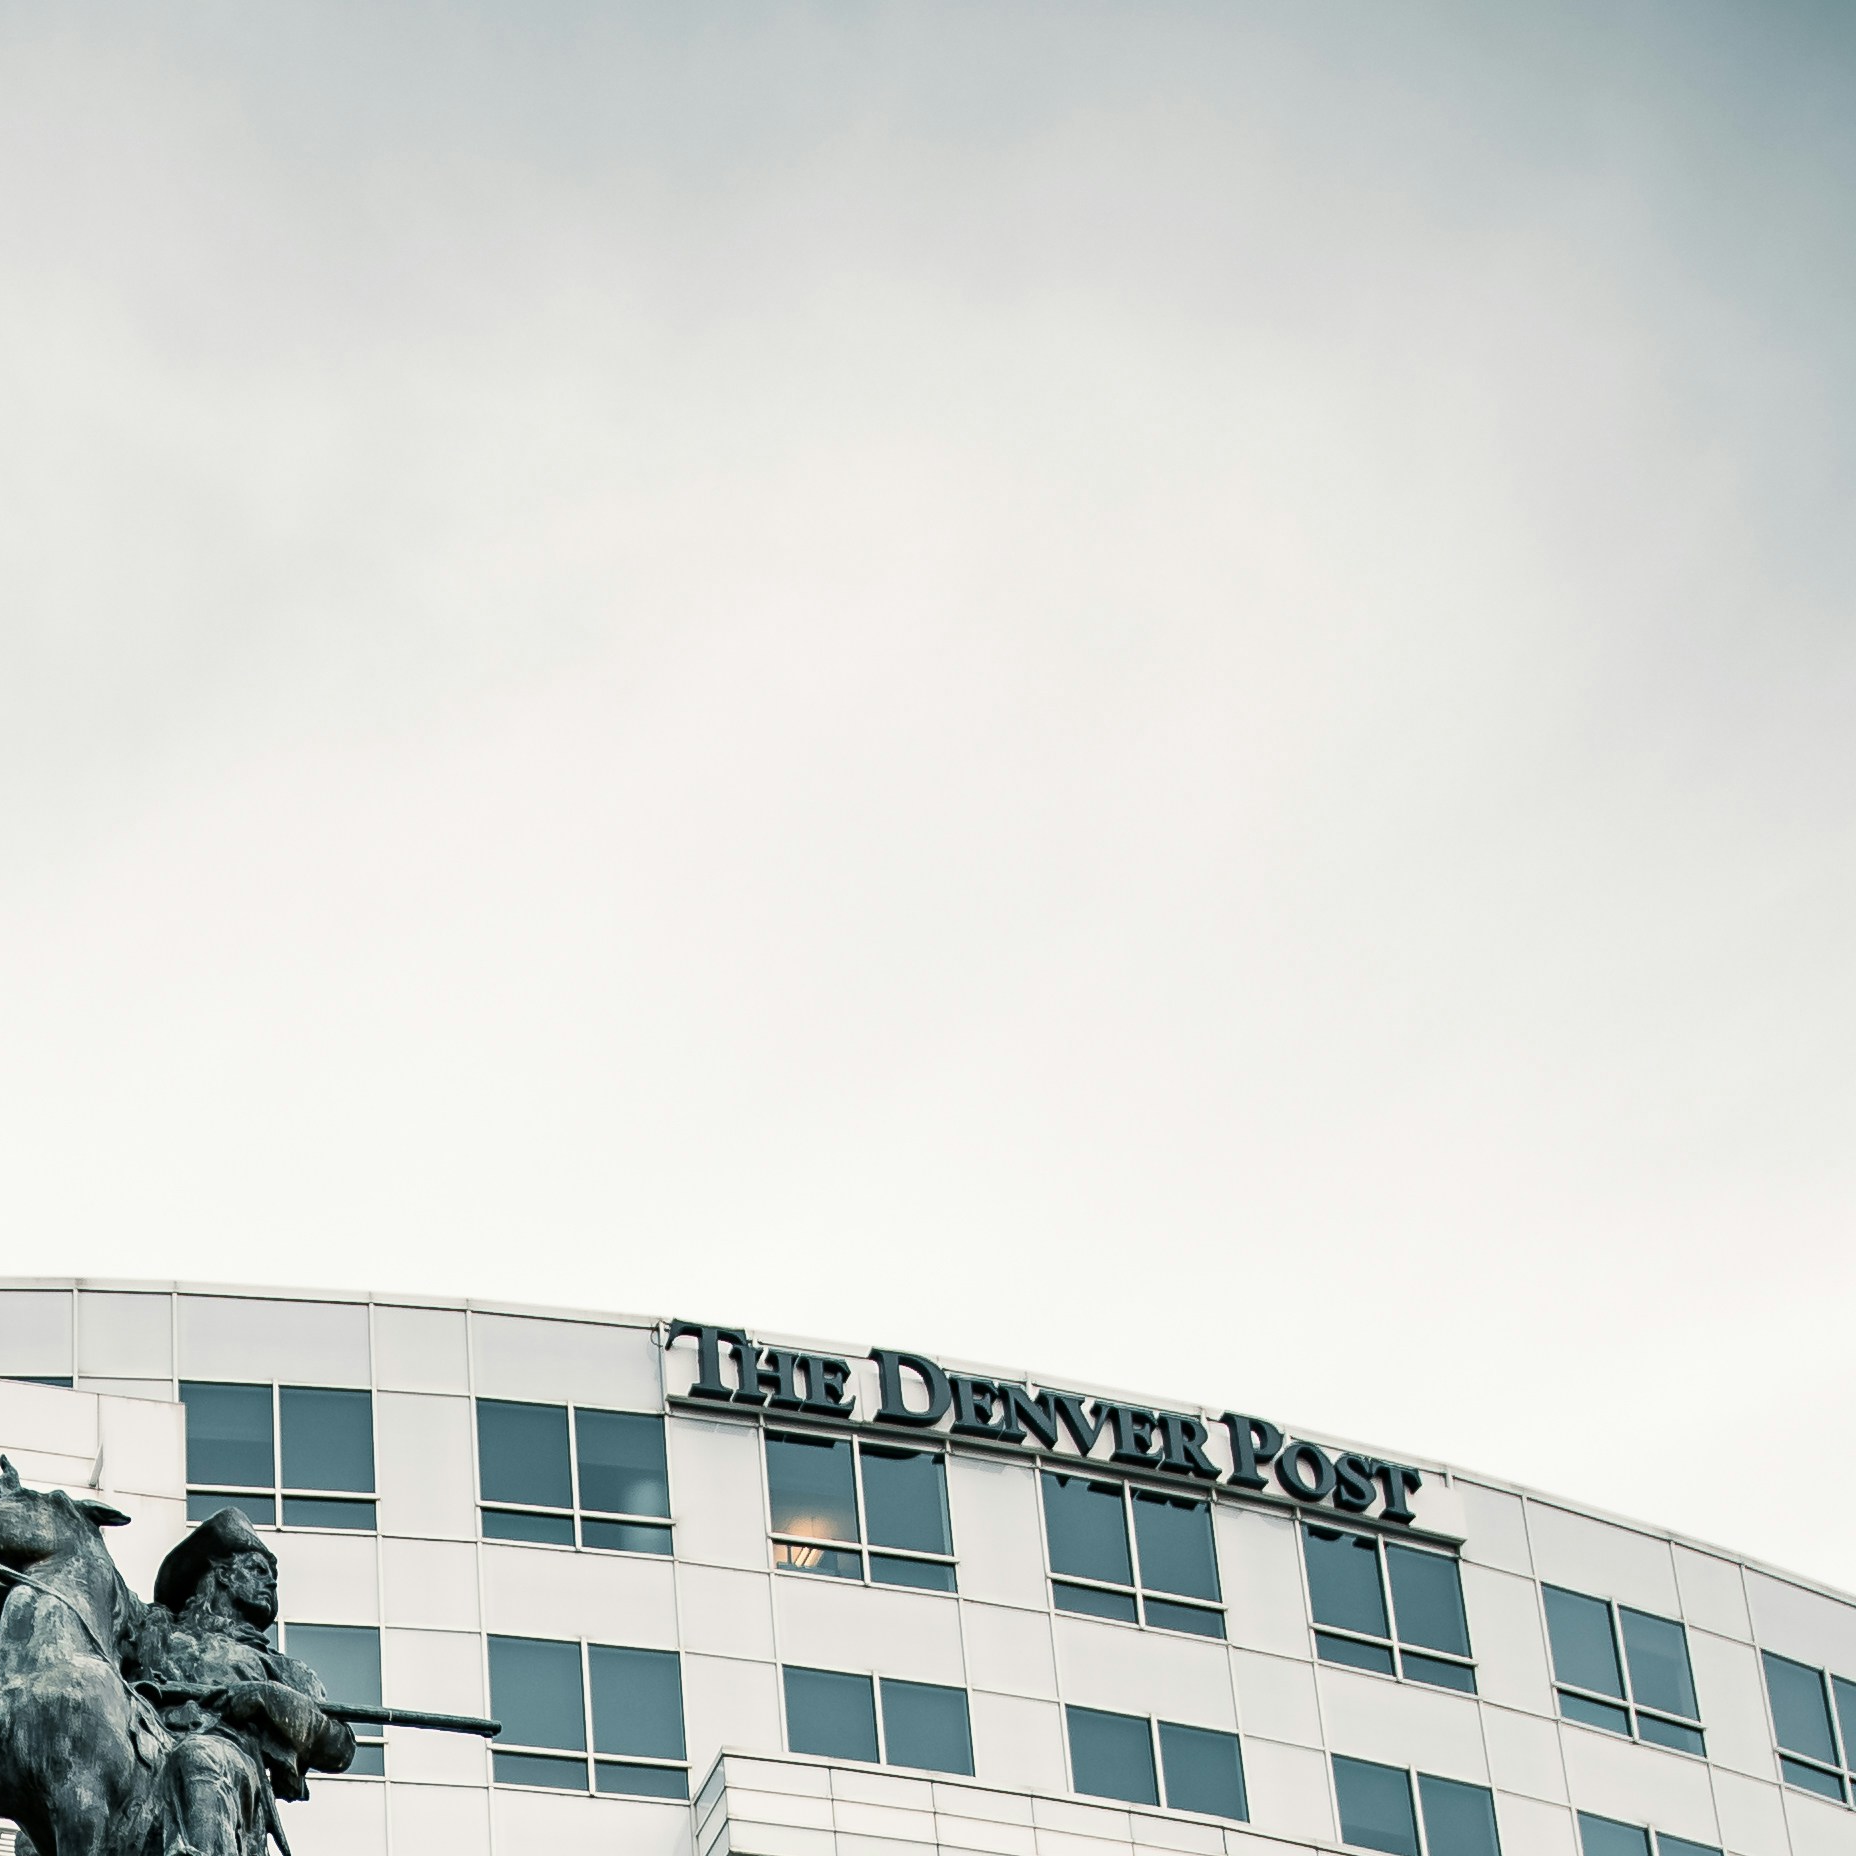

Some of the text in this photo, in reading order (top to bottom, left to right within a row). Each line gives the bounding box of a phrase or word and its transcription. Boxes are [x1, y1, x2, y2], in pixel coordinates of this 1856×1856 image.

[666, 1318, 1423, 1526] THE DENVER POST
